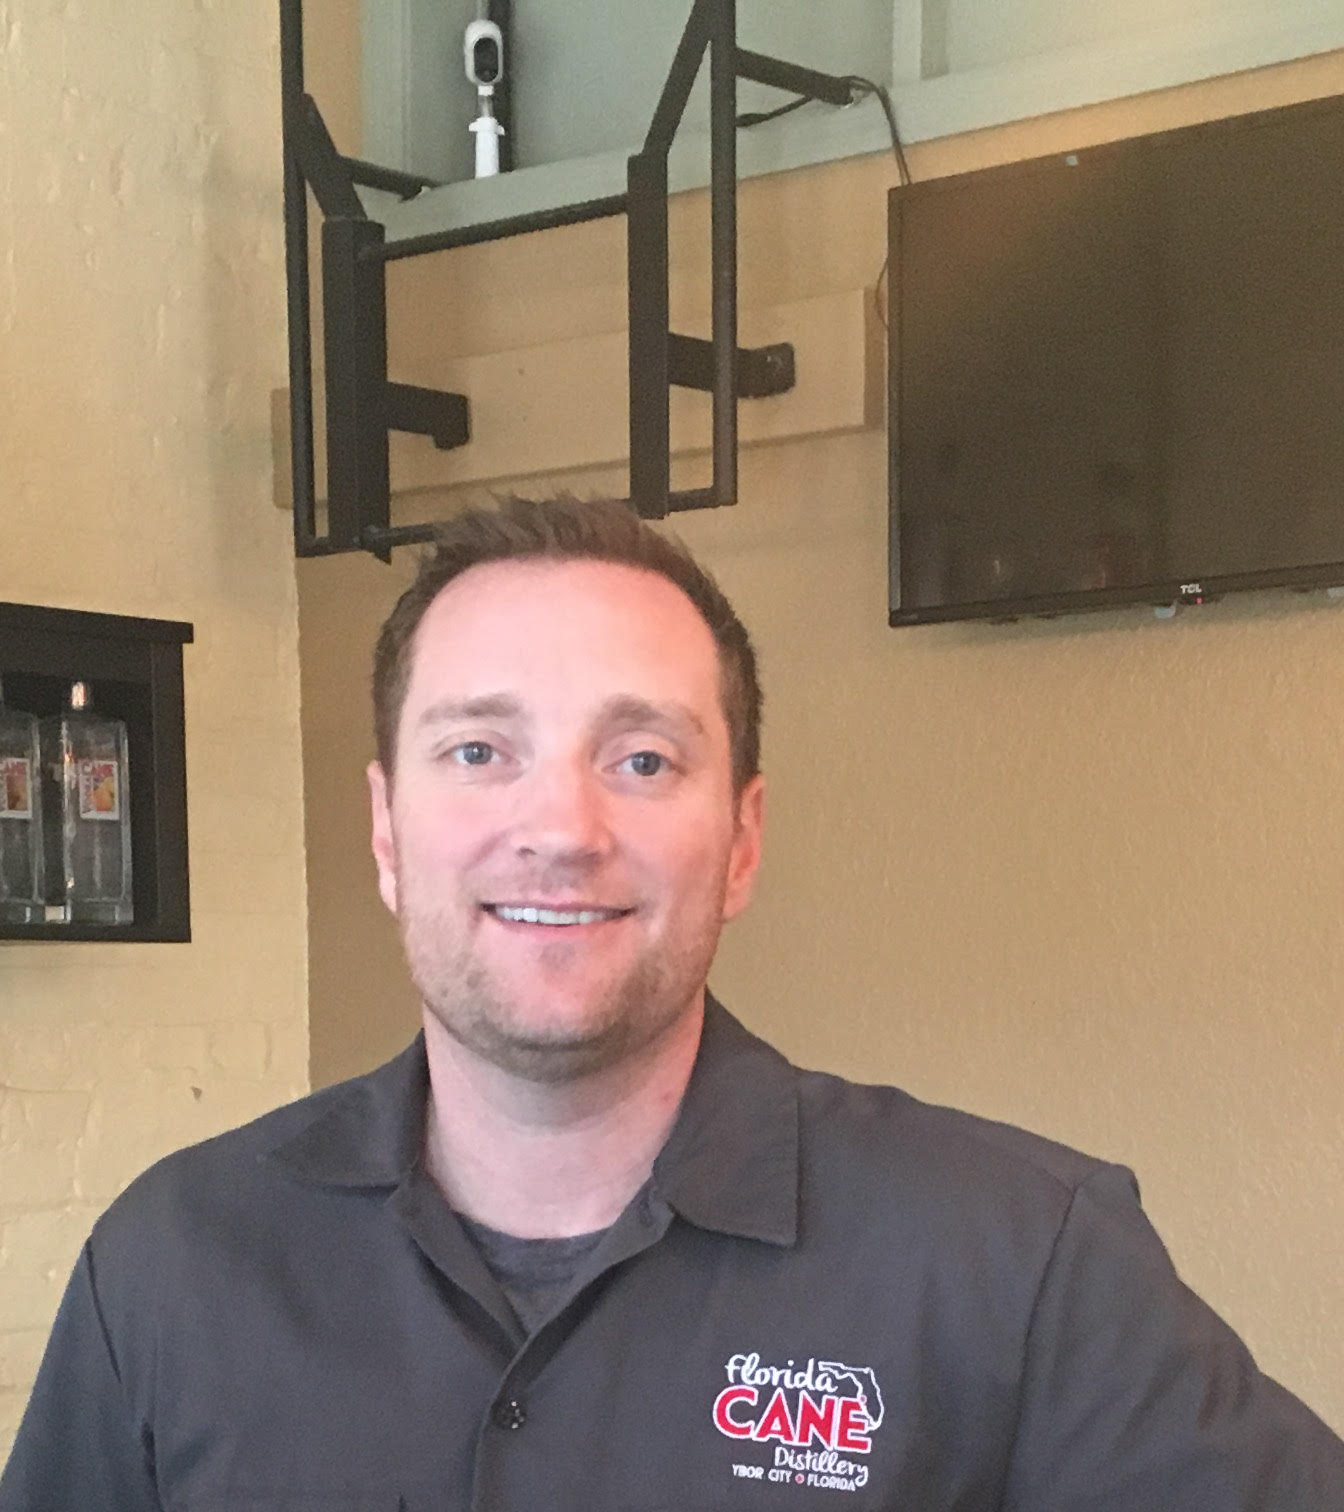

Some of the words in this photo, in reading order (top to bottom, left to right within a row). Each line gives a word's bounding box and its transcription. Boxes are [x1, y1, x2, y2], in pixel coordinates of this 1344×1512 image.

[1180, 583, 1202, 594] TCL
[712, 1385, 872, 1453] CANE
[732, 1464, 763, 1480] YBOR
[768, 1468, 792, 1484] CITY
[806, 1474, 856, 1492] FLORIDA
[774, 1447, 869, 1487] Distillery
